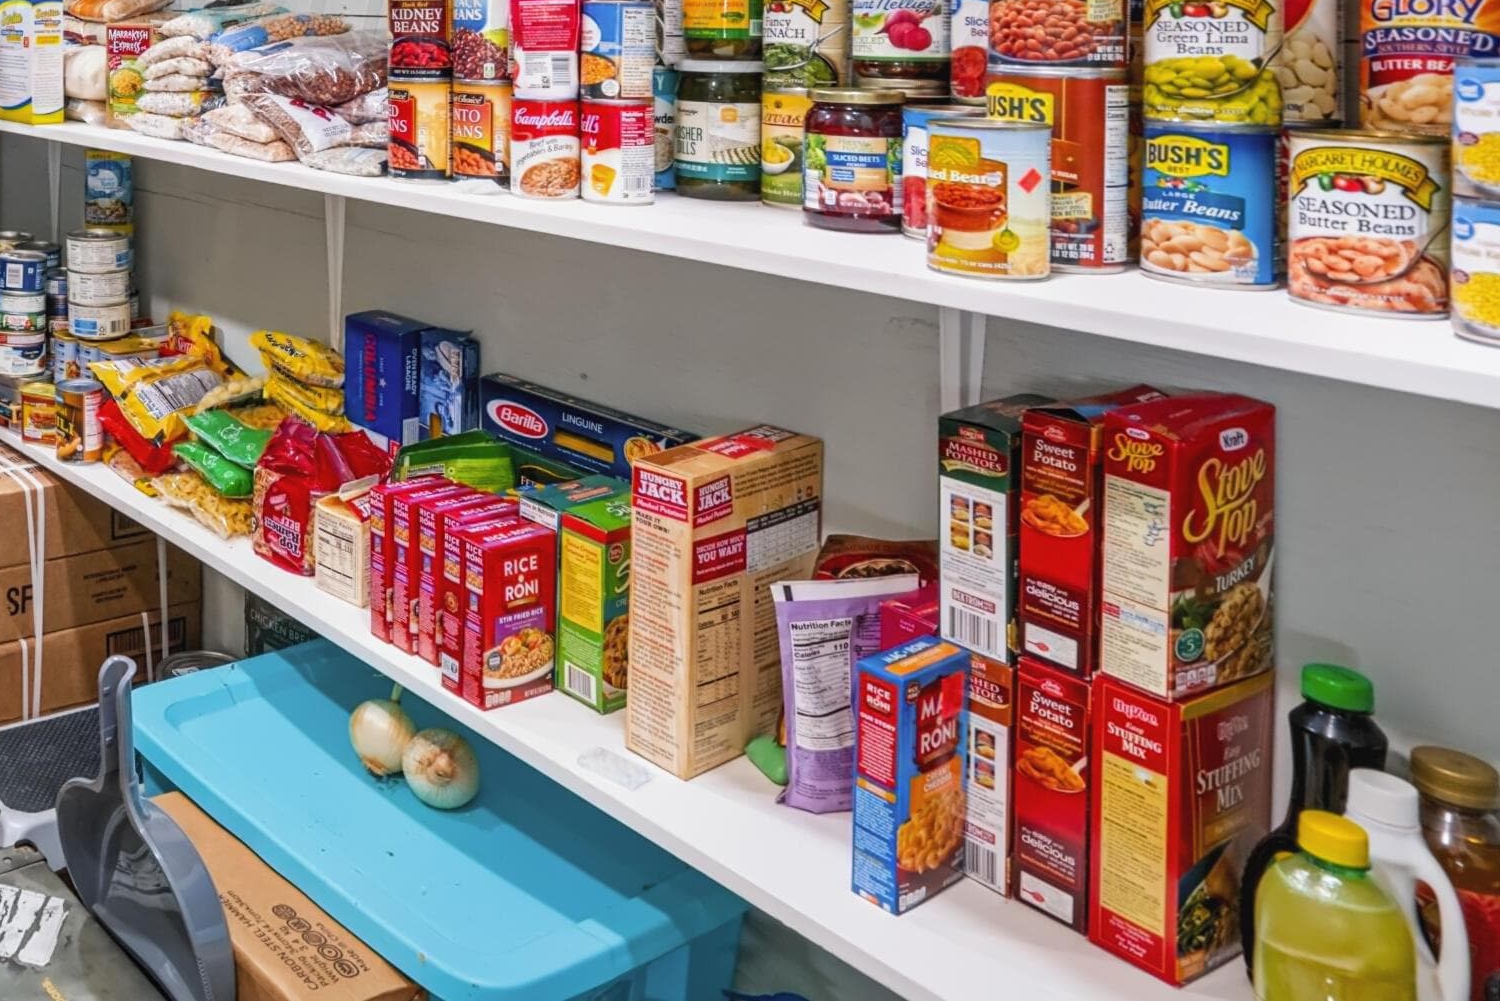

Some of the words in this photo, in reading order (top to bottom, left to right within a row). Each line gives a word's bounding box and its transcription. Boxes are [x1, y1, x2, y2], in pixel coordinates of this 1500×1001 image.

[392, 7, 443, 21] KIDNEY
[765, 18, 791, 31] Fancy
[394, 20, 440, 33] BEANS
[1156, 20, 1250, 33] SEASONED
[1156, 33, 1199, 44] Green
[1206, 32, 1249, 44] Lima
[1176, 43, 1224, 55] Beans
[1364, 28, 1495, 53] SEASONED
[1371, 59, 1422, 72] BUTTER
[514, 107, 574, 130] Campbell's
[1147, 142, 1225, 170] BUSH'S
[1361, 153, 1422, 182] HOLMES
[1167, 165, 1190, 174] BEST
[1161, 190, 1197, 200] LARGE
[1183, 199, 1243, 221] Beans
[1298, 197, 1418, 222] SEASONED
[1298, 214, 1349, 232] Butter
[1358, 218, 1416, 236] Beans
[499, 406, 543, 433] Barilla
[562, 412, 604, 434] LINGUINE
[1035, 439, 1075, 460] Sweet
[1108, 433, 1164, 461] Stove
[1222, 429, 1245, 449] Kraft
[945, 448, 1003, 472] POTATOES
[949, 442, 999, 462] MASHED
[1033, 450, 1077, 473] Potato
[1128, 455, 1156, 474] Top
[639, 470, 683, 490] HUNGRY
[699, 478, 729, 496] HUNGRY
[638, 481, 687, 505] JACK
[698, 487, 731, 511] JACK
[1183, 449, 1266, 543] Stove
[1215, 500, 1257, 559] Top
[698, 550, 717, 564] YOU
[718, 542, 743, 558] WANT
[504, 554, 538, 577] RICE
[1214, 555, 1257, 593] TURKEY
[505, 579, 539, 602] RONI
[1026, 585, 1080, 611] delicious
[499, 615, 513, 624] STIR
[513, 610, 531, 621] FRIED
[531, 606, 544, 617] RICE
[790, 621, 828, 632] Nutrition
[866, 682, 891, 700] RICE
[1030, 702, 1074, 729] Potato
[1032, 691, 1072, 717] Sweet
[921, 719, 957, 755] RONI
[1107, 721, 1163, 755] STUFFING
[1197, 747, 1261, 795] STUFFING
[1021, 834, 1076, 866] delicious
[253, 928, 278, 951] STEEL
[277, 951, 319, 991] CARBON
